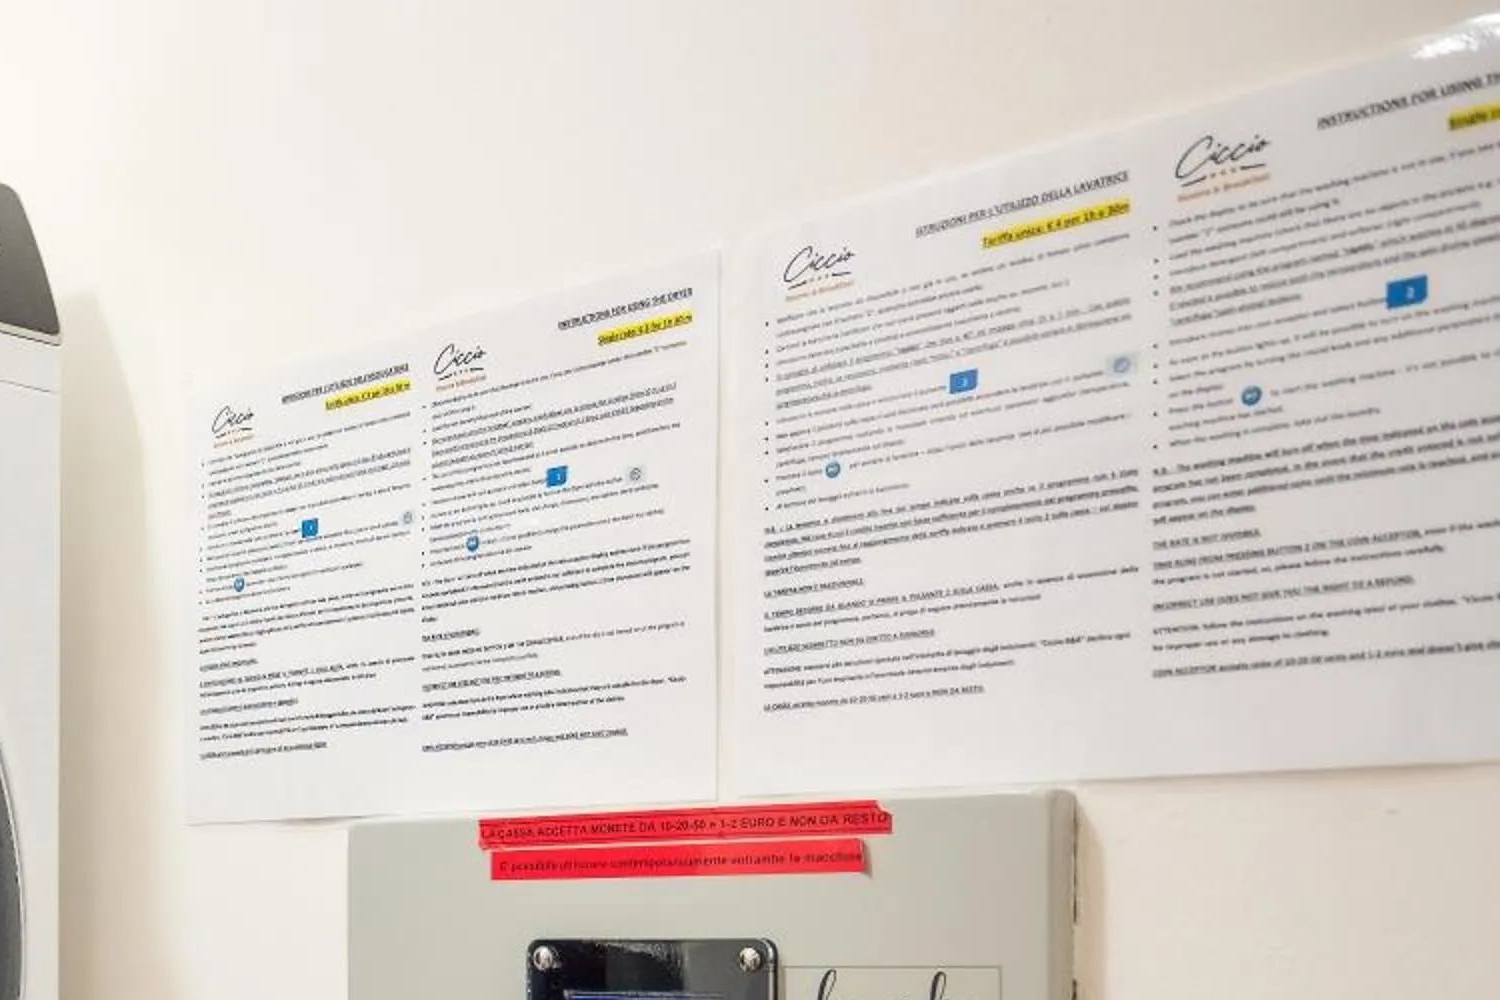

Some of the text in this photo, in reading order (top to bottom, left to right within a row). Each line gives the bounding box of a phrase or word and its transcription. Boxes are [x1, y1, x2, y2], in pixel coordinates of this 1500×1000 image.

[1174, 135, 1272, 179] Ciccio
[783, 245, 855, 282] Ciccio
[740, 817, 774, 828] EURO
[789, 815, 818, 826] NON
[843, 811, 888, 825] RESTO
